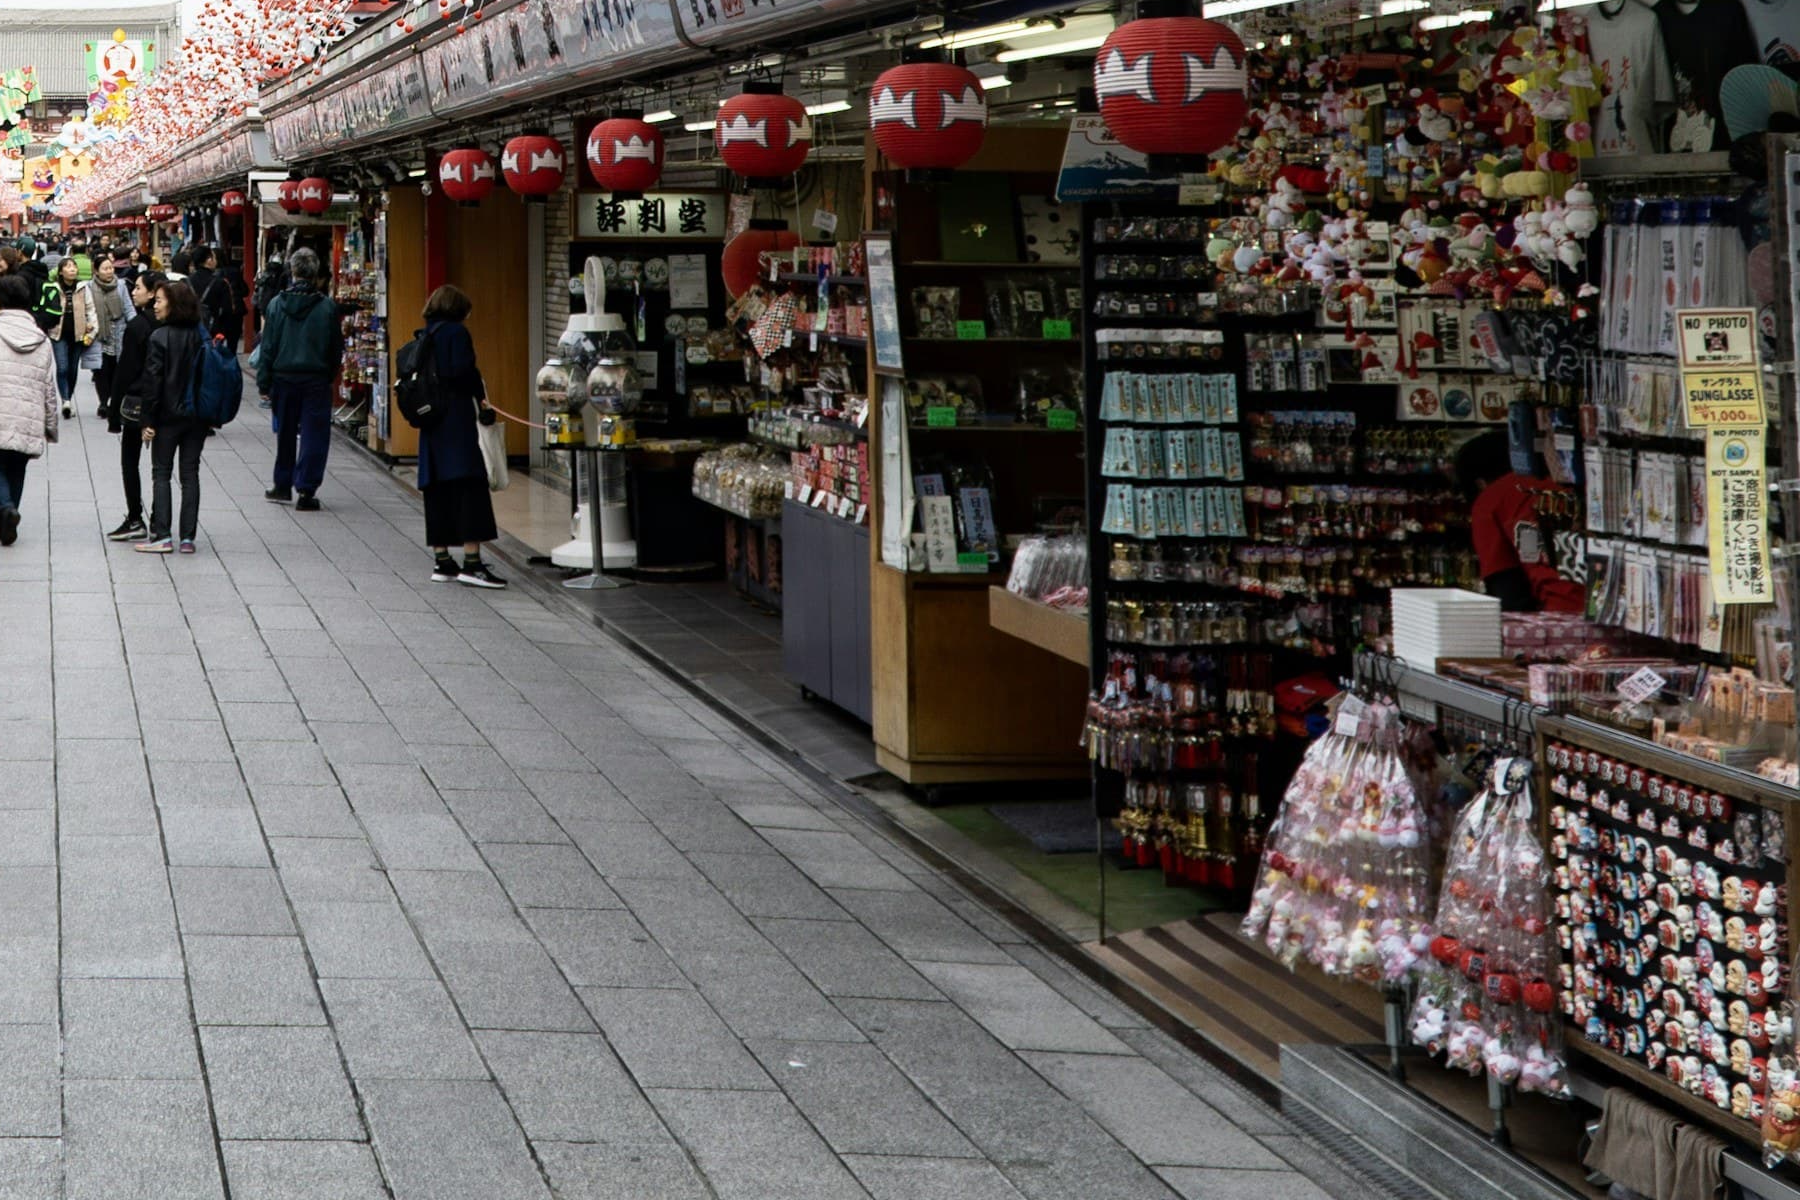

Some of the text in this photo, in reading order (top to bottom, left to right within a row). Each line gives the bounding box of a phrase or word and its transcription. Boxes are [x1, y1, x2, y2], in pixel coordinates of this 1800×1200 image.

[597, 198, 706, 233] 評判堂
[1685, 317, 1747, 329] NO PHOTO
[1701, 377, 1742, 387] サングラス
[1690, 389, 1755, 401] SUNGLASSE
[1746, 479, 1765, 595] 商品につき撮影は
